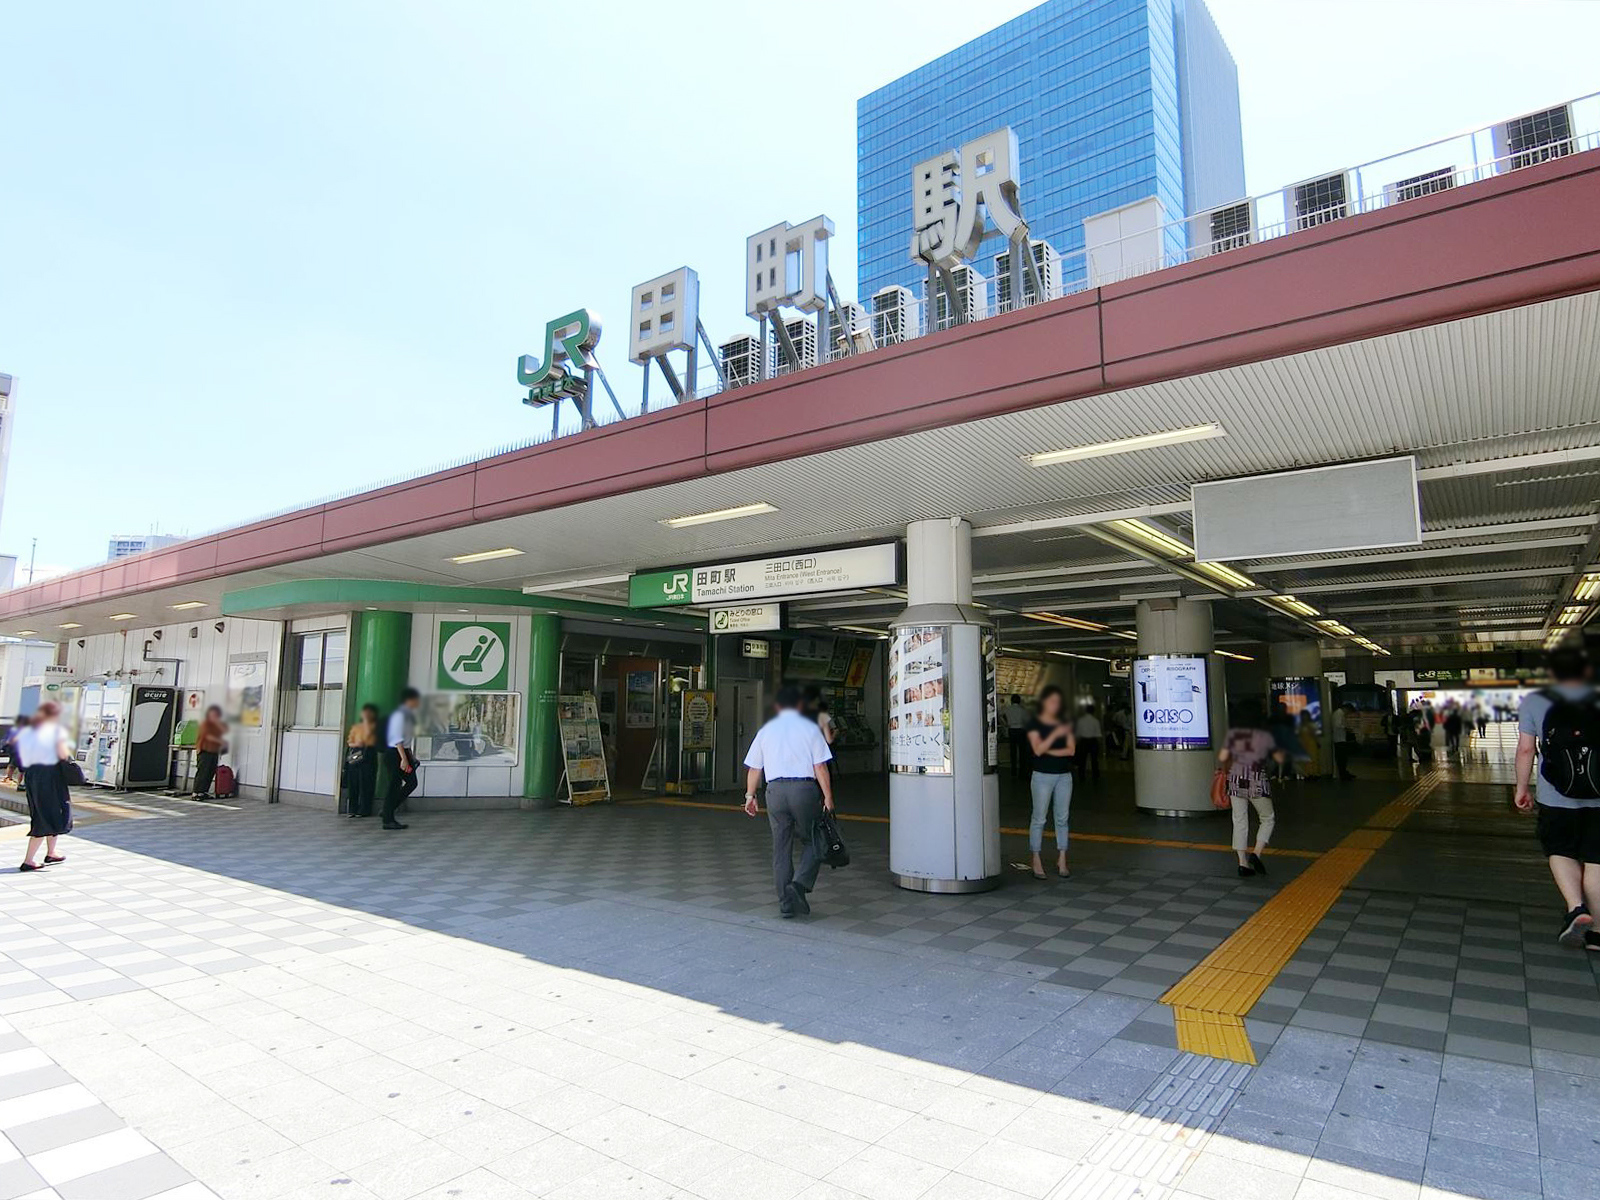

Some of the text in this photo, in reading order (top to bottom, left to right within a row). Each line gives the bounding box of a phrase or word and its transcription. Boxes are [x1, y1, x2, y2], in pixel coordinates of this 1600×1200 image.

[517, 308, 602, 388] JR
[696, 568, 736, 586] 田町駅
[764, 567, 843, 582] Mita Entrance (West Entrance)
[663, 573, 689, 594] JR
[697, 584, 755, 597] Tamachi Station
[666, 593, 685, 601] JR東日本
[729, 607, 763, 617] みどりの窓口
[1155, 708, 1194, 724] RISO
